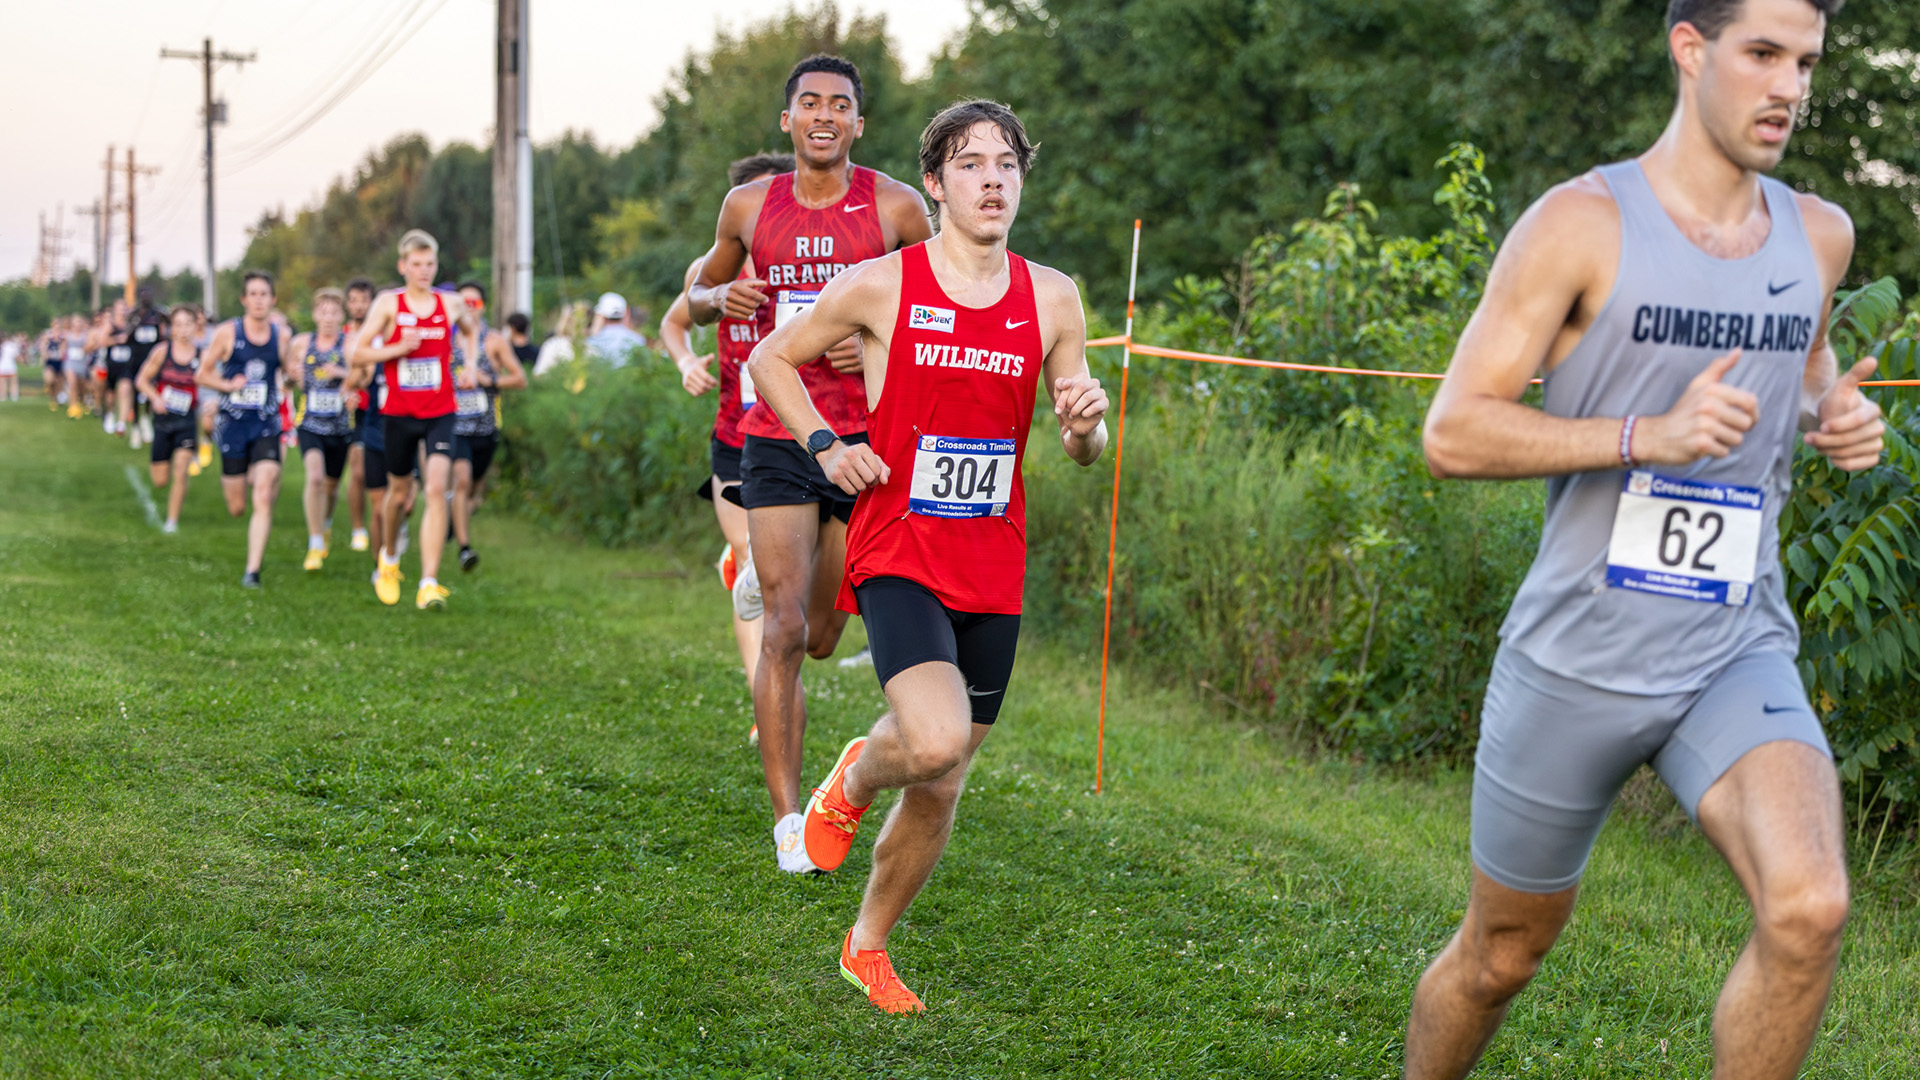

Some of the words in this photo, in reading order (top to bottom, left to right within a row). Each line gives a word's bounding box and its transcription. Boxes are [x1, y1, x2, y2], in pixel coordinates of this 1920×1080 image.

[795, 236, 834, 258] RIO
[769, 263, 855, 286] GRAN
[790, 293, 818, 301] Crossro
[1632, 305, 1812, 351] CUMBERLANDS
[915, 343, 1024, 377] WILDCATS
[937, 440, 987, 451] Crossroads
[989, 443, 1015, 452] Timing
[932, 456, 998, 500] 304
[1652, 478, 1724, 501] Crossroads
[1726, 488, 1760, 507] Timing
[1658, 506, 1724, 571] 62
